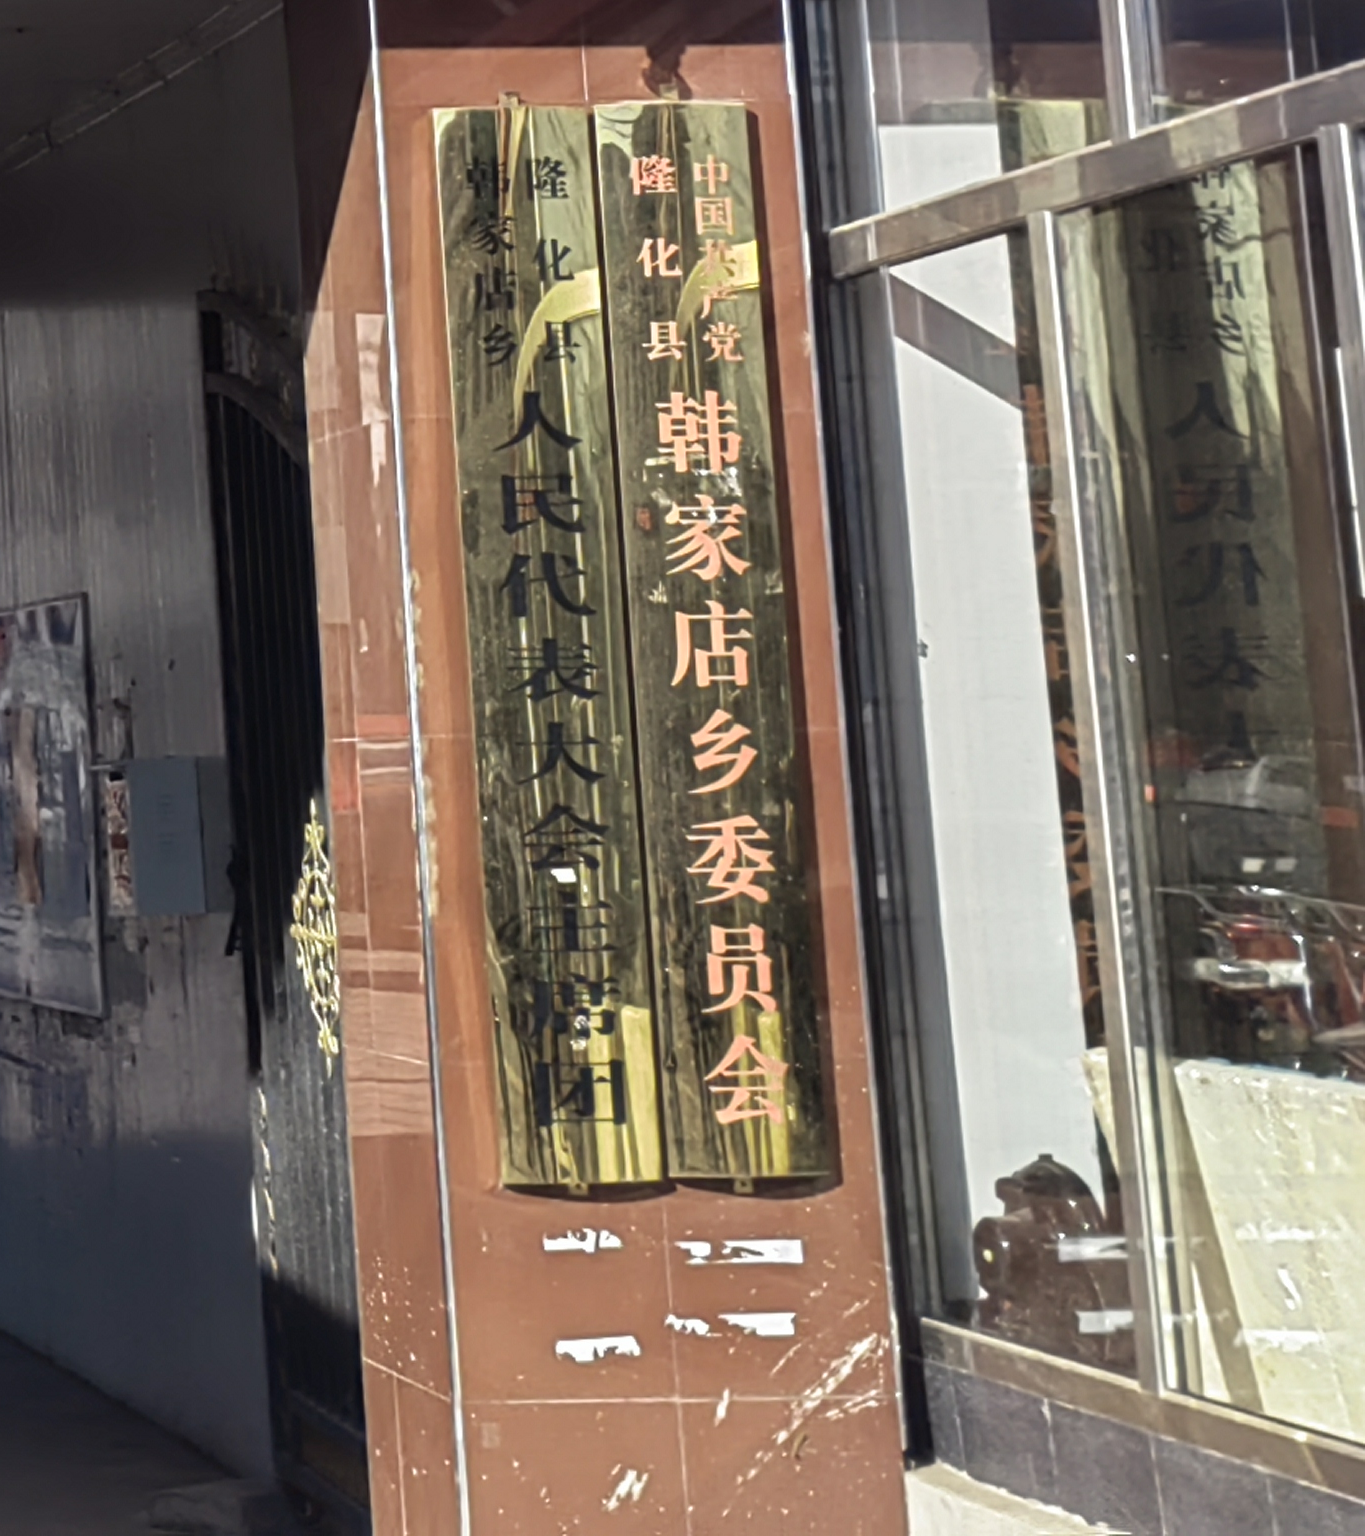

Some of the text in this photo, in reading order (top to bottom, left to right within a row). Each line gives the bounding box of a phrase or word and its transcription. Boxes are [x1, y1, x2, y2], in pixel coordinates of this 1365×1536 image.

[465, 155, 518, 365] 韩家店乡
[526, 156, 580, 364] 隆化县
[629, 156, 687, 361] 隆化县
[692, 154, 744, 363] 中国共产党
[656, 390, 788, 1125] 韩家店乡委员会
